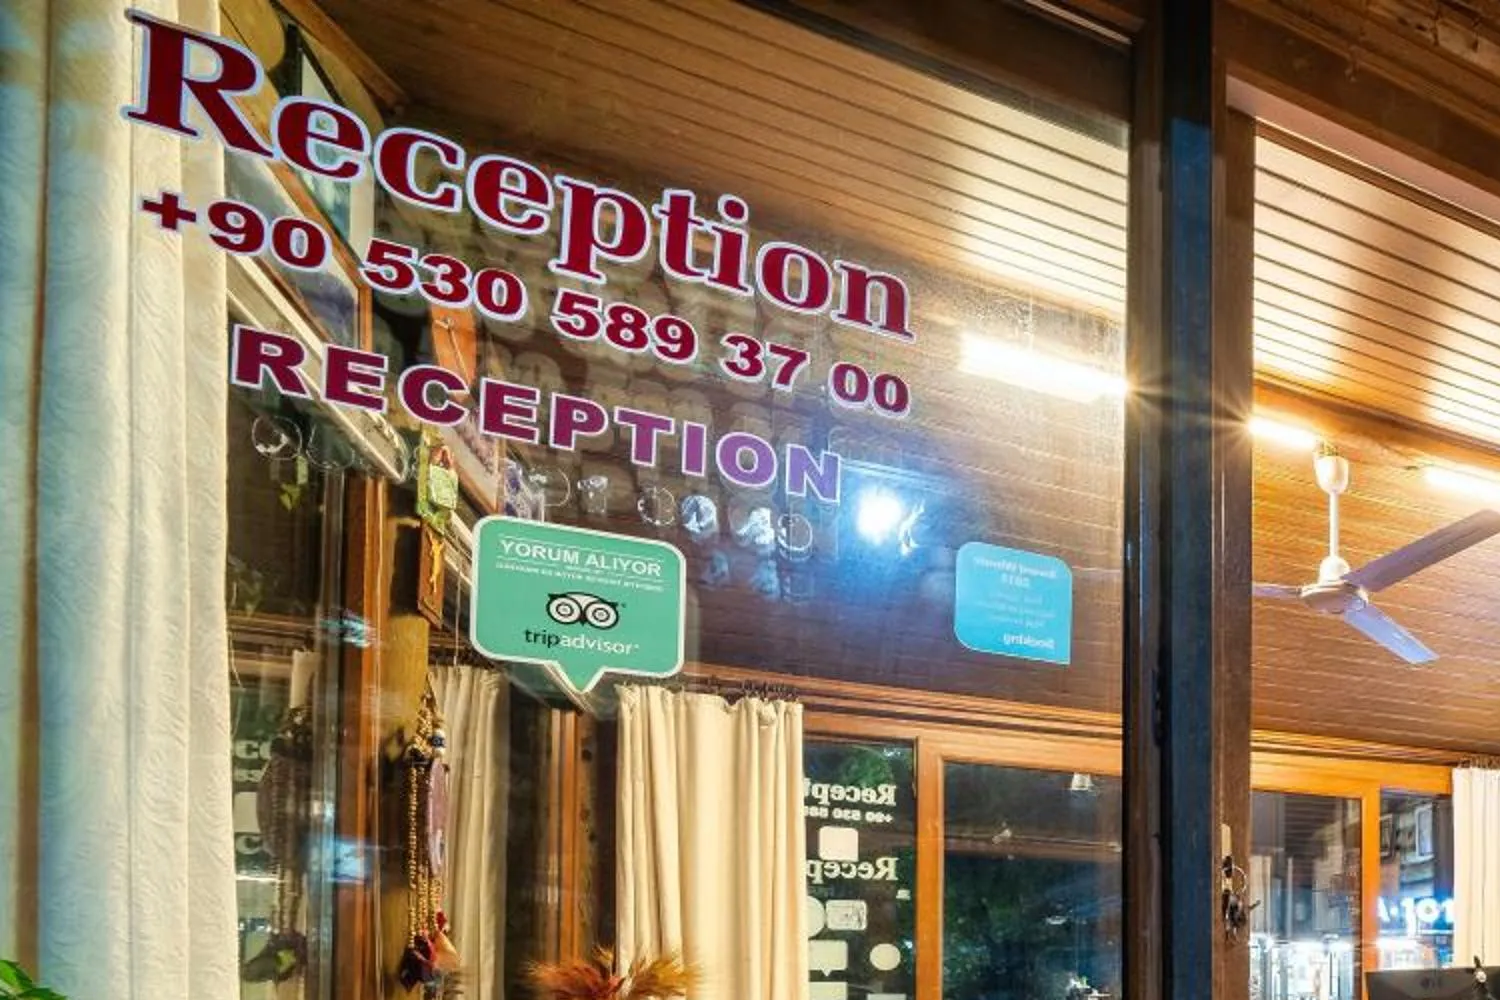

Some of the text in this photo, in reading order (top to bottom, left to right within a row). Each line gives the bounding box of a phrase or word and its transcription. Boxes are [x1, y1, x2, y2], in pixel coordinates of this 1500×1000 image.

[124, 11, 914, 342] Reception
[142, 191, 911, 419] +90 530 589 37 00
[231, 323, 842, 504] RECEPTION
[501, 540, 579, 564] YORUM
[585, 555, 662, 577] ALIYOR
[524, 629, 633, 655] tripadvisor
